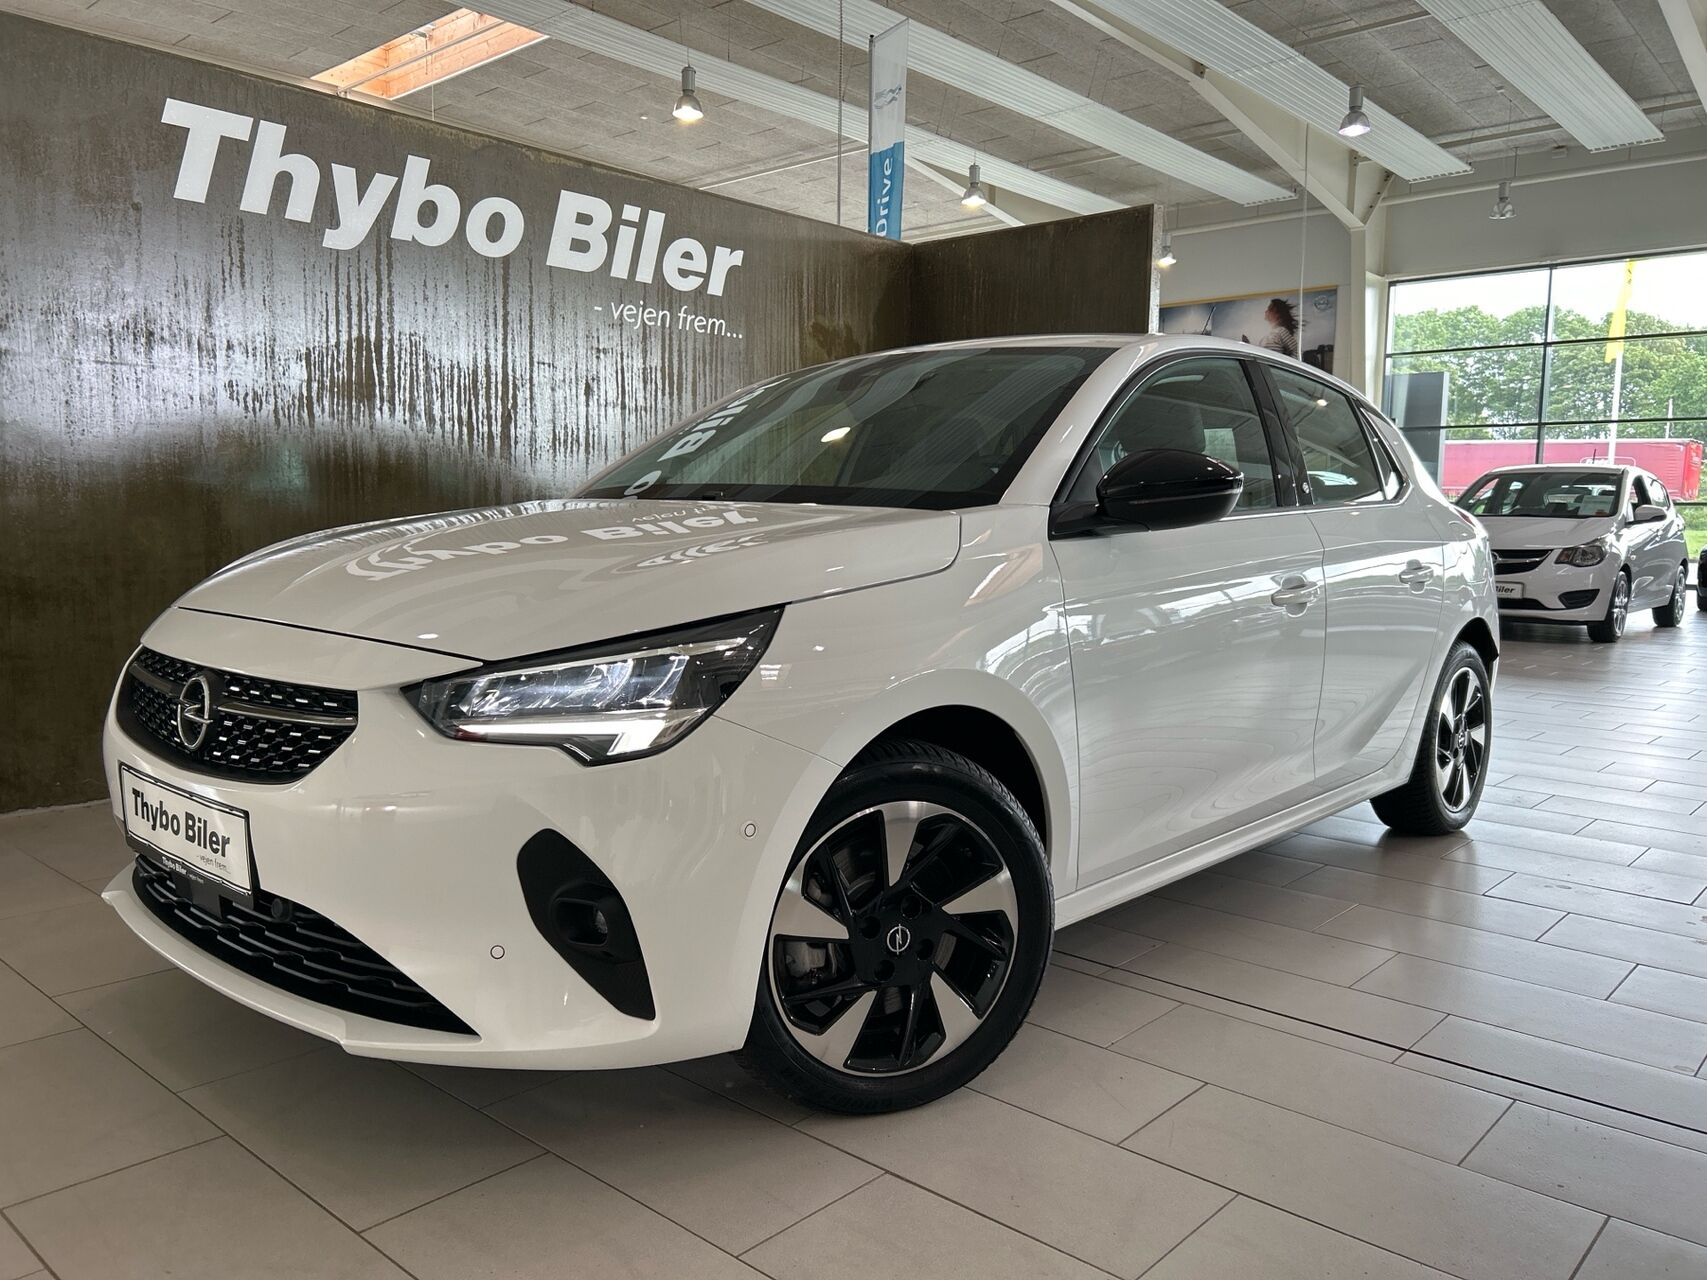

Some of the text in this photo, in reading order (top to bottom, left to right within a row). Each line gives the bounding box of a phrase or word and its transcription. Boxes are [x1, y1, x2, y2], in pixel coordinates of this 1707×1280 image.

[161, 98, 744, 297] Thybo Biler
[876, 157, 893, 238] Drive
[610, 300, 671, 330] vejen
[677, 305, 743, 339] frem...
[131, 787, 231, 858] Thybo Biler
